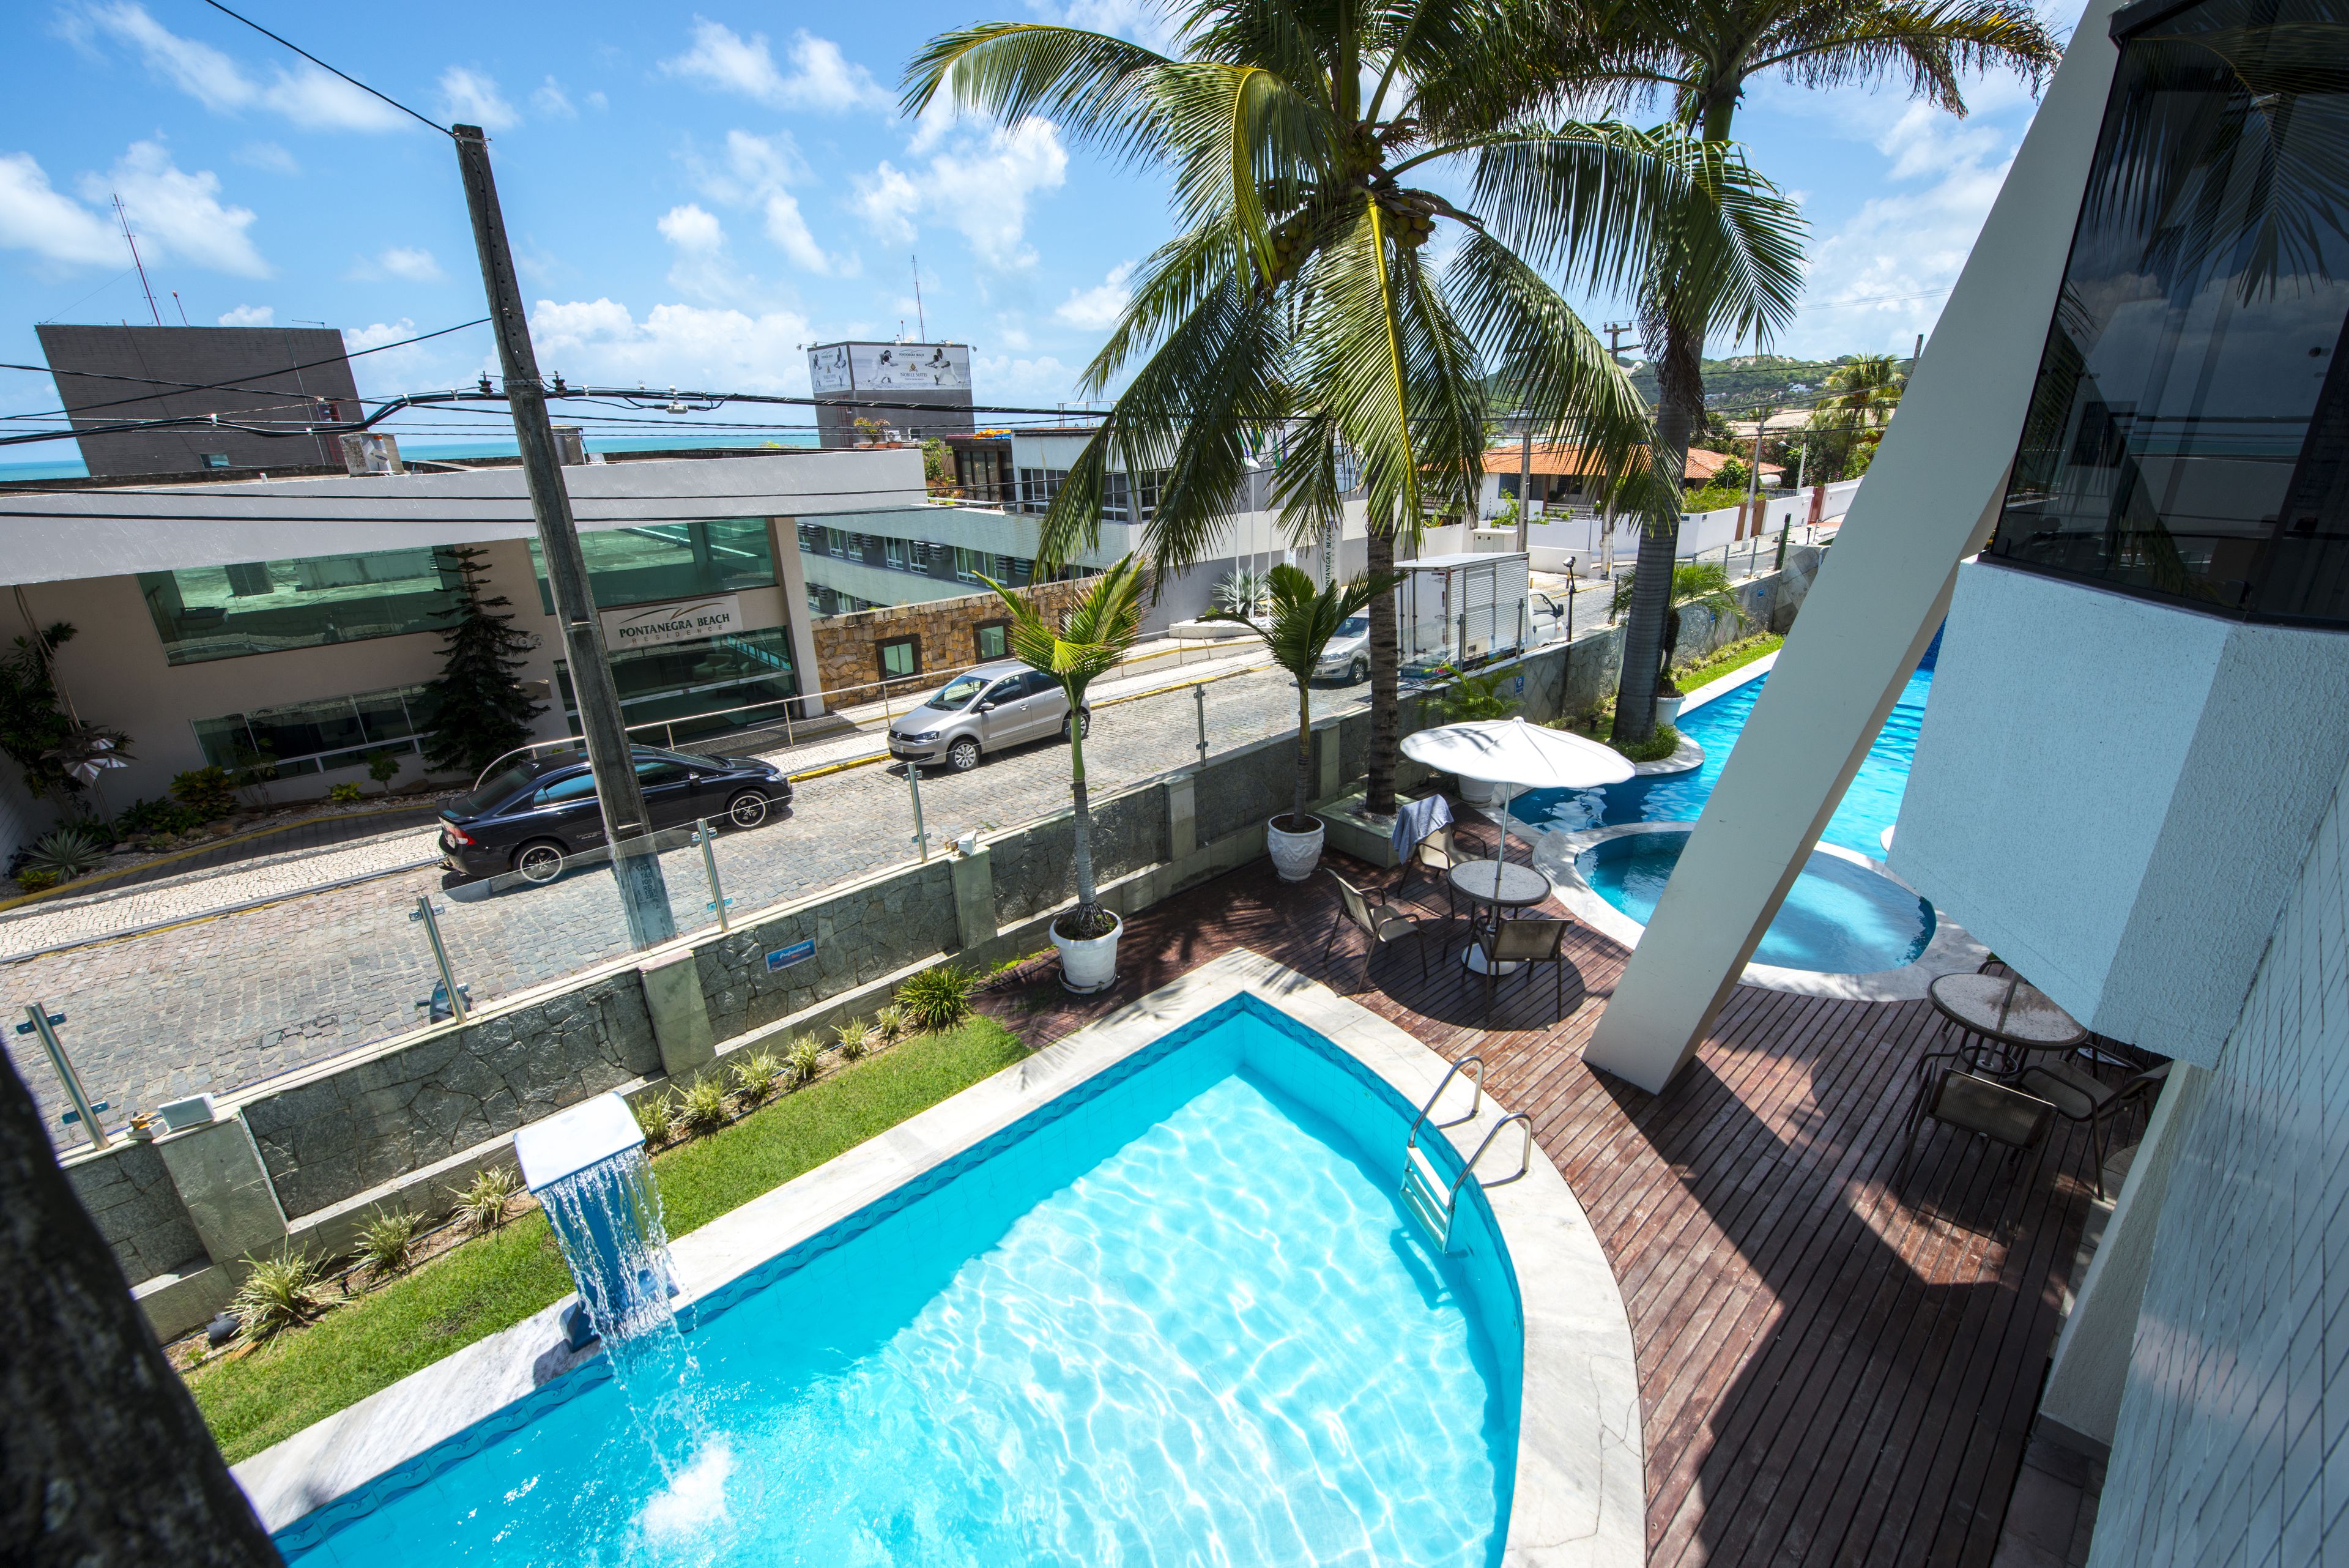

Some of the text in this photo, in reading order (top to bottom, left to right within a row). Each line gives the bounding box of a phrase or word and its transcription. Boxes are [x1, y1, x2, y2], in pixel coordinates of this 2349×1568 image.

[619, 613, 730, 638] PONTANEGRA BEACH
[632, 625, 723, 643] RESIDENCE
